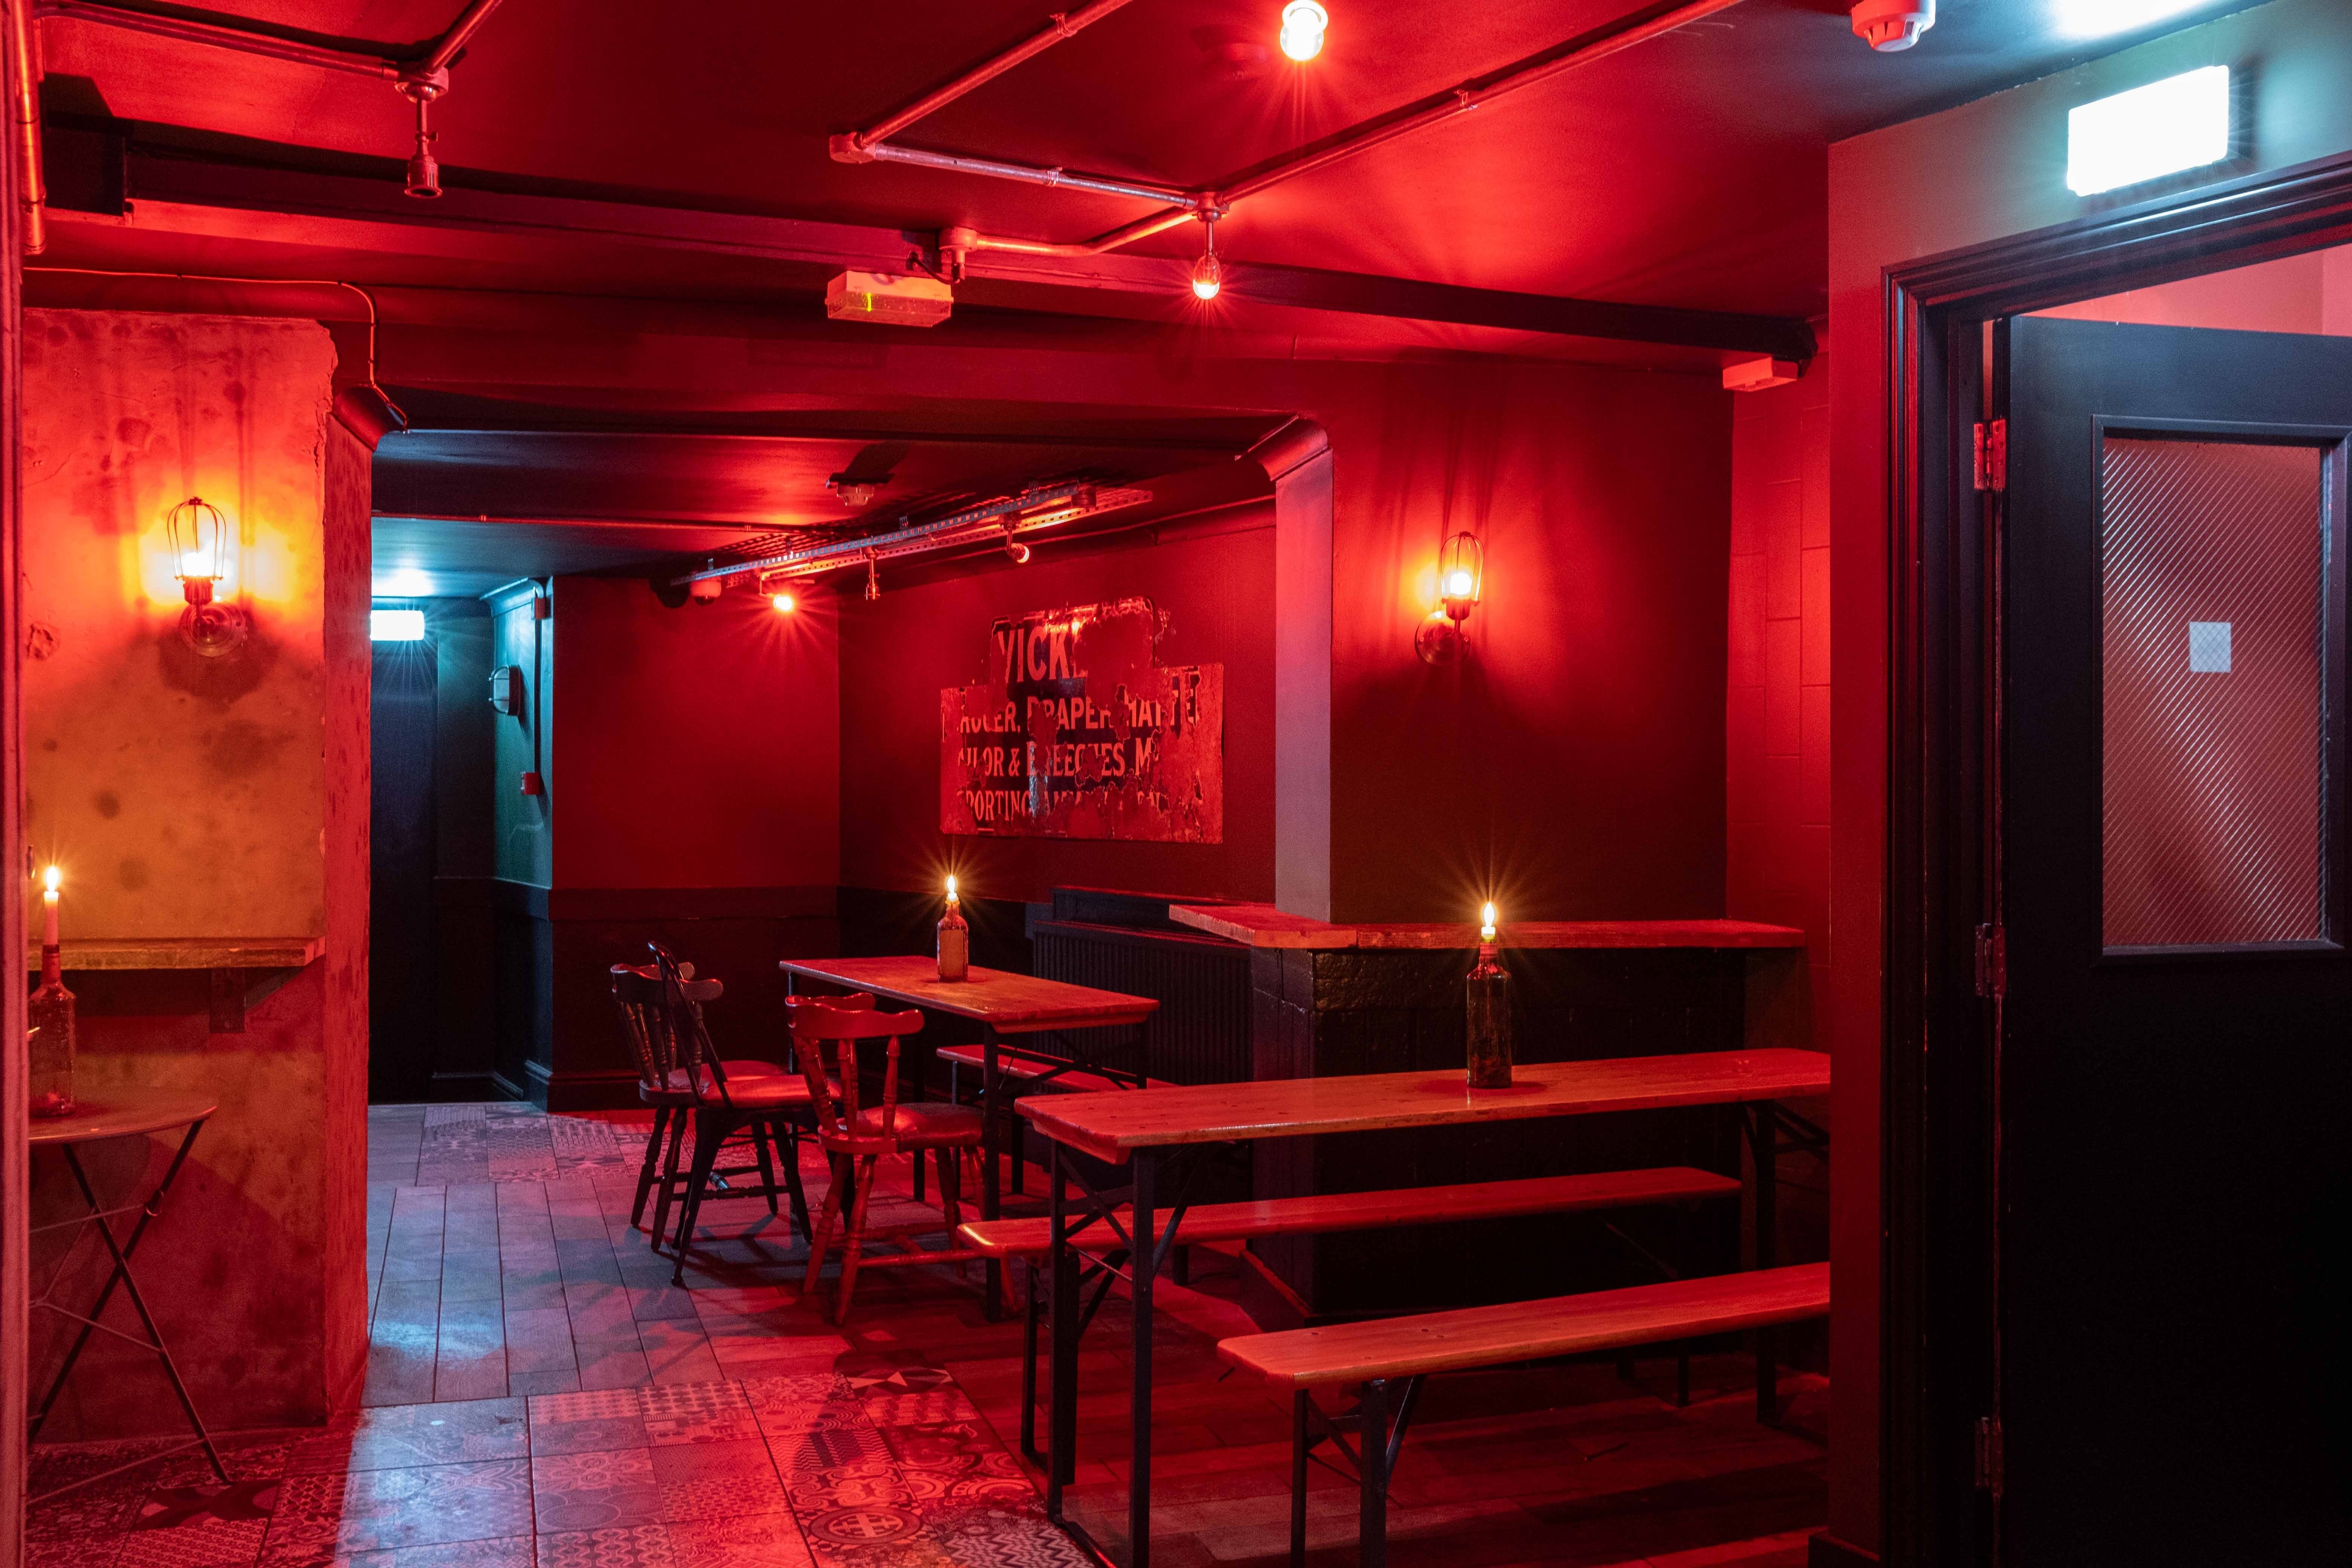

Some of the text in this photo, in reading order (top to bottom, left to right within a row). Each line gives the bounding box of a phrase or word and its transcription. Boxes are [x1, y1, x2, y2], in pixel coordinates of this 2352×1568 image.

[1008, 747, 1020, 777] &
[1027, 741, 1126, 777] BEECES
[957, 790, 1032, 821] PORTING
